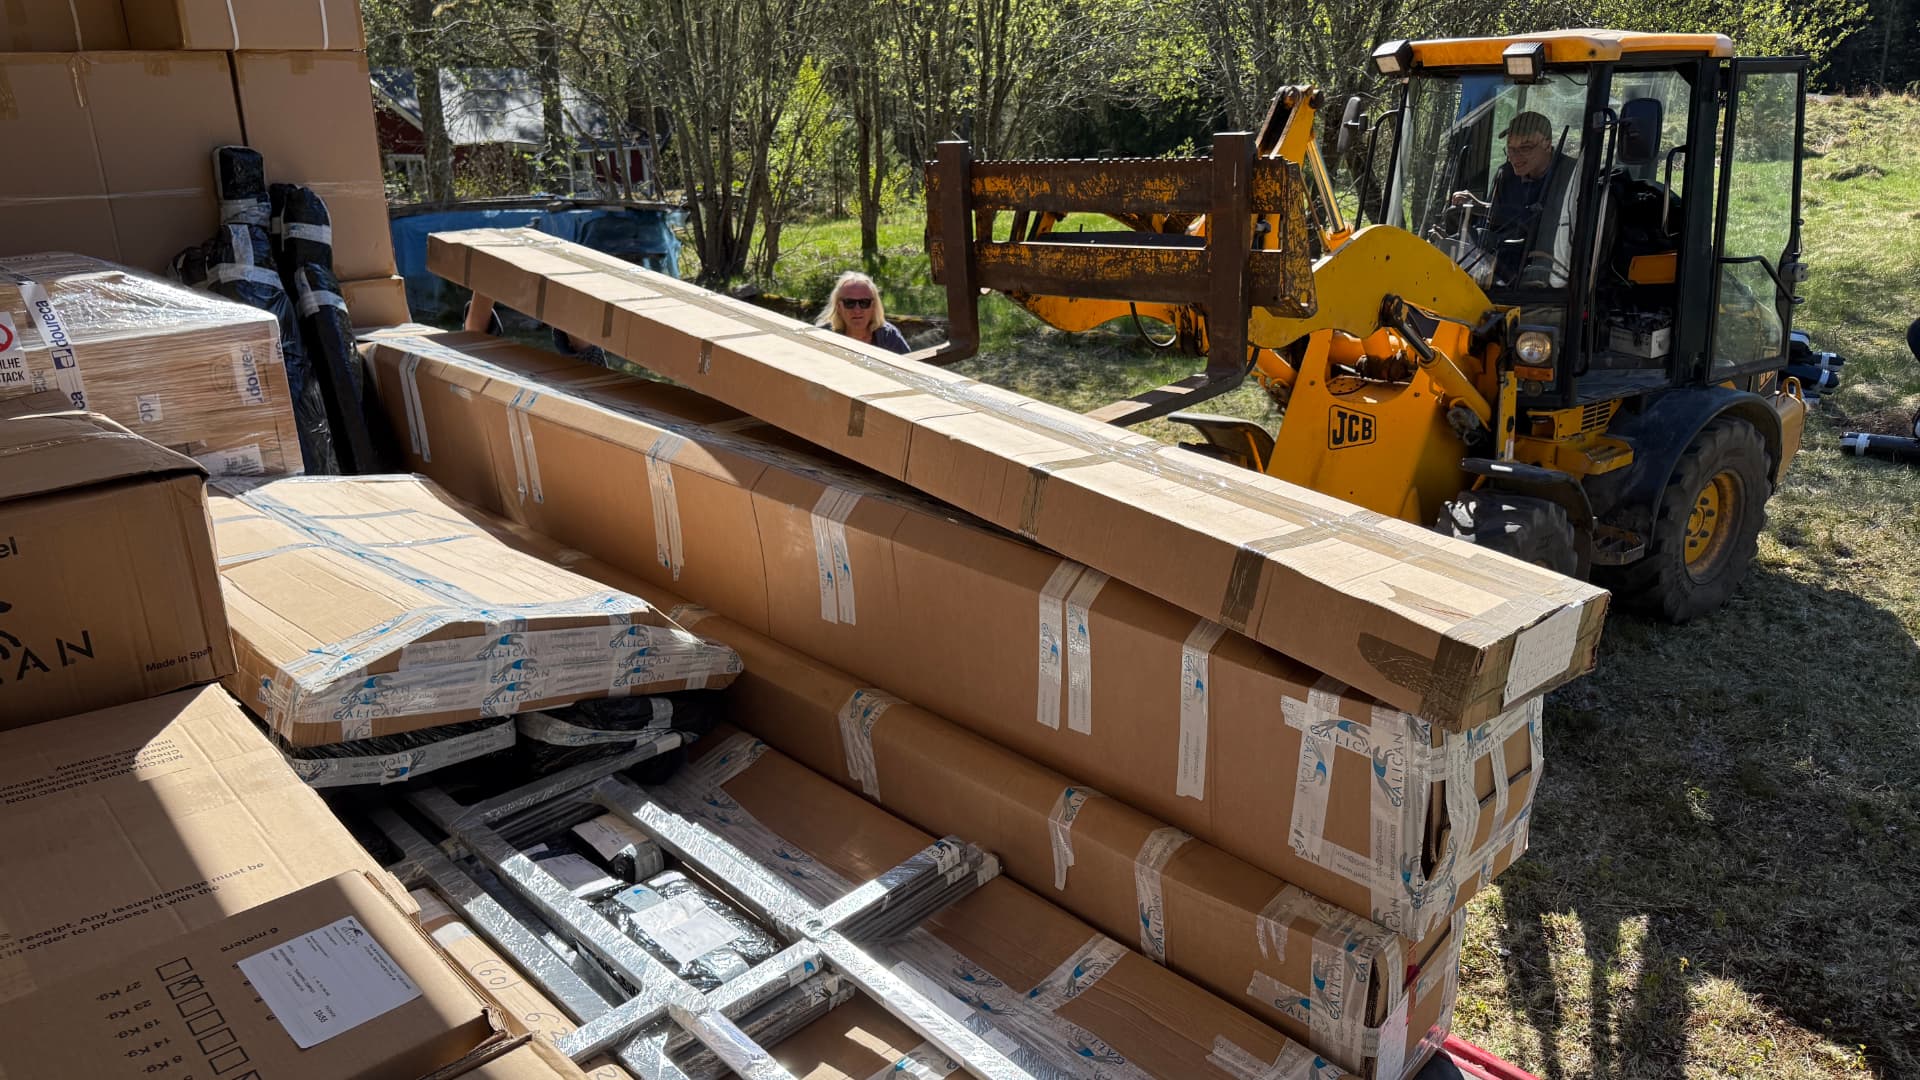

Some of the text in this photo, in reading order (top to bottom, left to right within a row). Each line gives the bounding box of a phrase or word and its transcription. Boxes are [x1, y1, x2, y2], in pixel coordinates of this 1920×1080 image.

[36, 300, 68, 347] doureca
[0, 370, 25, 383] TACK
[1333, 411, 1372, 445] JCB
[0, 630, 94, 685] AN
[477, 647, 537, 660] GALICAN
[146, 658, 175, 673] Made
[178, 655, 188, 664] in
[490, 670, 550, 684] GALICAN
[613, 672, 664, 687] GALICAN
[483, 690, 543, 706] GALICAN
[55, 753, 112, 772] company
[143, 748, 180, 761] Check
[1391, 732, 1404, 807] GALICAN
[5, 753, 184, 805] MERCHANDISE INSPECTION
[19, 923, 77, 944] receipt.
[80, 911, 108, 925] Any
[112, 879, 209, 915] issue/damage
[212, 867, 246, 883] must
[247, 862, 265, 872] be
[27, 933, 69, 951] order
[72, 926, 88, 936] to
[91, 907, 149, 931] process
[153, 903, 163, 911] it
[165, 892, 195, 907] with
[198, 884, 220, 896] the
[220, 933, 267, 953] meters
[133, 999, 152, 1012] 23
[144, 1018, 161, 1030] 19
[154, 1036, 171, 1049] 14
[172, 1055, 183, 1063] 8
